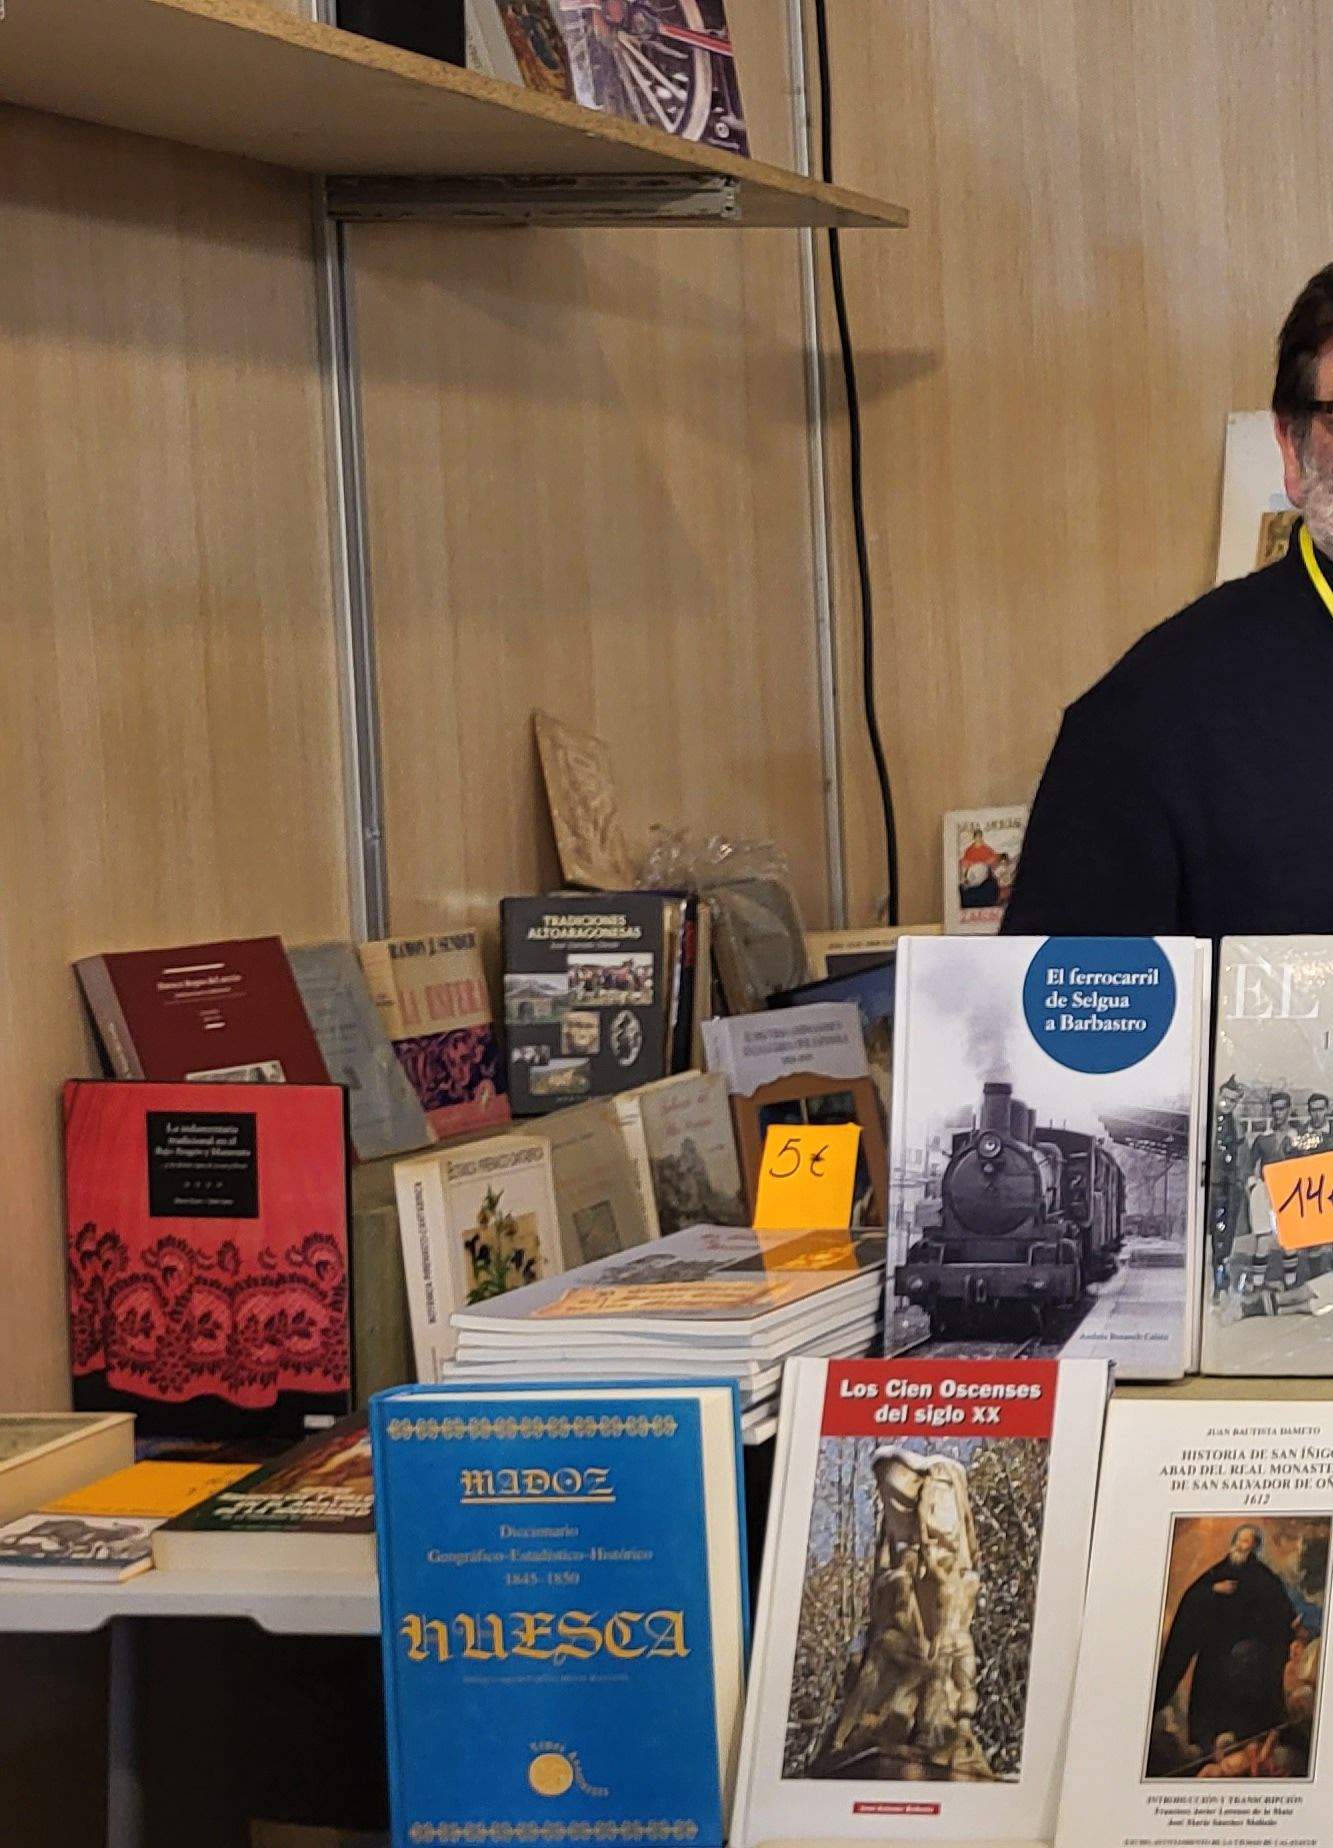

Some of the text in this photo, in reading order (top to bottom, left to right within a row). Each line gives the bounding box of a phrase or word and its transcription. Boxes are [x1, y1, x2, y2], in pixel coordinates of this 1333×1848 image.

[542, 914, 627, 927] TRADICIONES
[1046, 966, 1160, 987] El ferrocarril
[1225, 962, 1320, 1021] EL
[1045, 991, 1131, 1014] de Selgua
[1045, 1014, 1148, 1034] a Barbastro
[839, 1377, 1042, 1401] Los Cien Oscenses
[873, 1403, 1002, 1428] del siglo XX
[1206, 1426, 1231, 1437] JUAN
[1232, 1426, 1279, 1437] BAUTISTA
[1180, 1448, 1248, 1462] HISTORIA
[1249, 1448, 1269, 1461] DE
[1270, 1448, 1299, 1461] SAN
[1159, 1463, 1198, 1477] ABAD
[1199, 1463, 1228, 1476] DEL
[1229, 1463, 1266, 1475] REAL
[459, 1466, 617, 1497] MADOZ
[1170, 1478, 1191, 1492] DE
[1191, 1478, 1221, 1491] SAN
[1221, 1478, 1293, 1491] SALVADOR
[1293, 1478, 1314, 1490] DE
[1242, 1493, 1272, 1506] 1612
[499, 1523, 580, 1539] Diccionario
[400, 1609, 692, 1666] HUESCA
